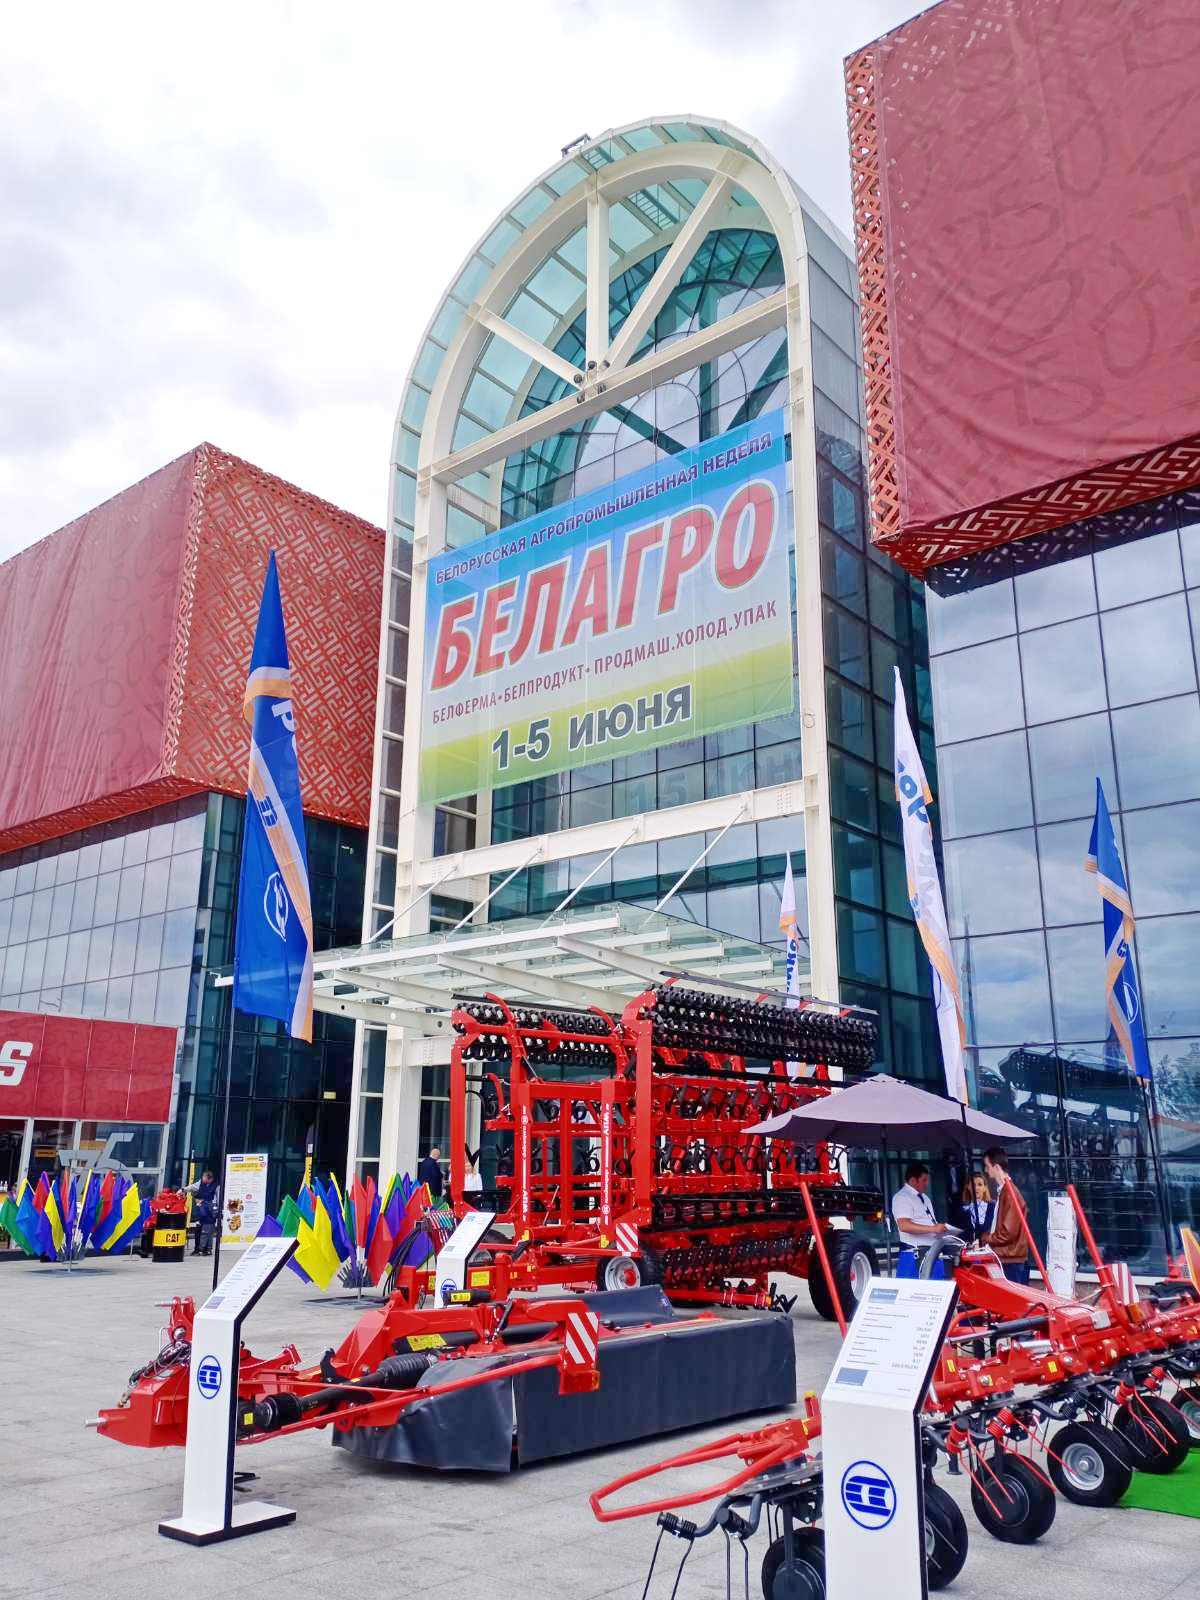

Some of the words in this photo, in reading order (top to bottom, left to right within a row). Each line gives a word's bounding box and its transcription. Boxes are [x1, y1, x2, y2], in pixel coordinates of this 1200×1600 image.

[436, 537, 526, 584] БЕЛОРУССКАЯ
[531, 464, 698, 547] АГРОПРОМЫШЛЕННАЯ
[703, 432, 772, 475] НЕДЕЛЯ
[430, 481, 777, 691] БЕЛАГРО
[493, 718, 551, 770] 1-5
[569, 684, 691, 751] ИЮНЯ
[166, 1233, 180, 1243] CAT
